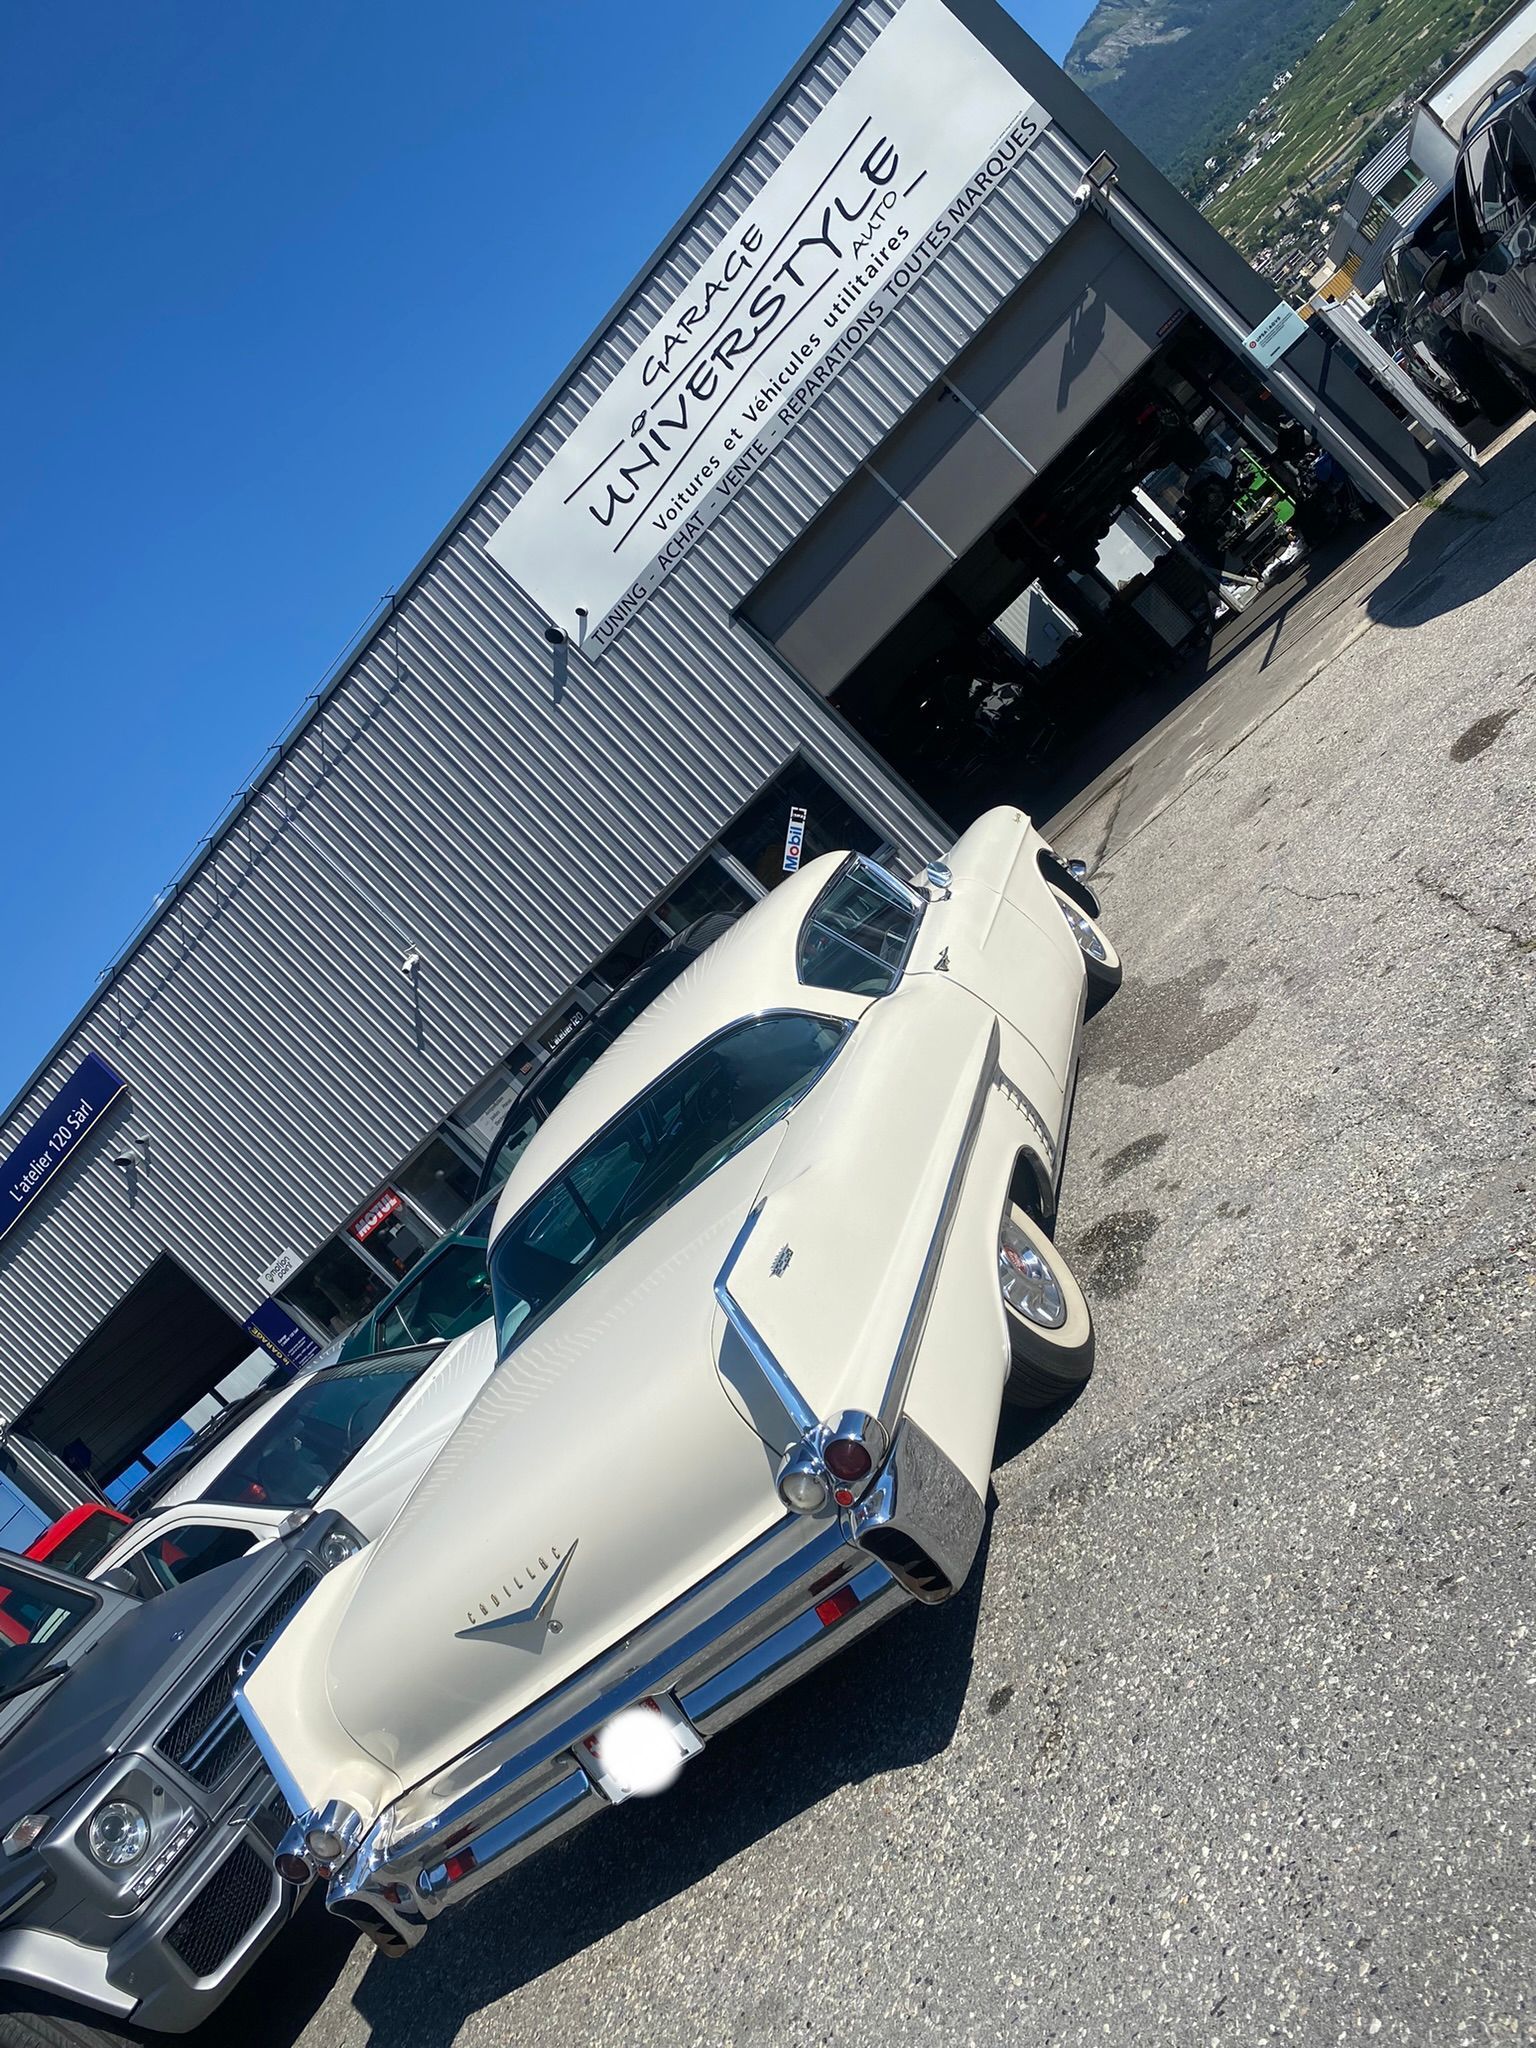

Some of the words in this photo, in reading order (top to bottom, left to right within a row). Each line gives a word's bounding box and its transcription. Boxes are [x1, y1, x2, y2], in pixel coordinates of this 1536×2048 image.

[853, 191, 897, 260] AUTO
[589, 136, 899, 526] UNIVERSTYLE
[642, 224, 763, 387] GARAGE
[591, 583, 647, 645] TUNING
[656, 511, 706, 571] ACHAT
[716, 438, 768, 497] VENTE
[777, 300, 884, 426] REPARATIONS
[883, 220, 951, 298] TOUTES
[948, 116, 1037, 224] MARQUES
[652, 455, 720, 531] Voitures
[723, 428, 743, 451] et
[742, 332, 821, 423] Véhicules
[823, 225, 909, 328] utilitaires
[785, 826, 802, 869] Mobil
[9, 1151, 53, 1202] L'atelier
[49, 1126, 72, 1151] 120
[355, 1194, 398, 1237] MOTUL
[277, 1260, 293, 1280] point
[250, 1327, 285, 1359] GARAGE
[467, 1546, 561, 1624] CADILLAC
